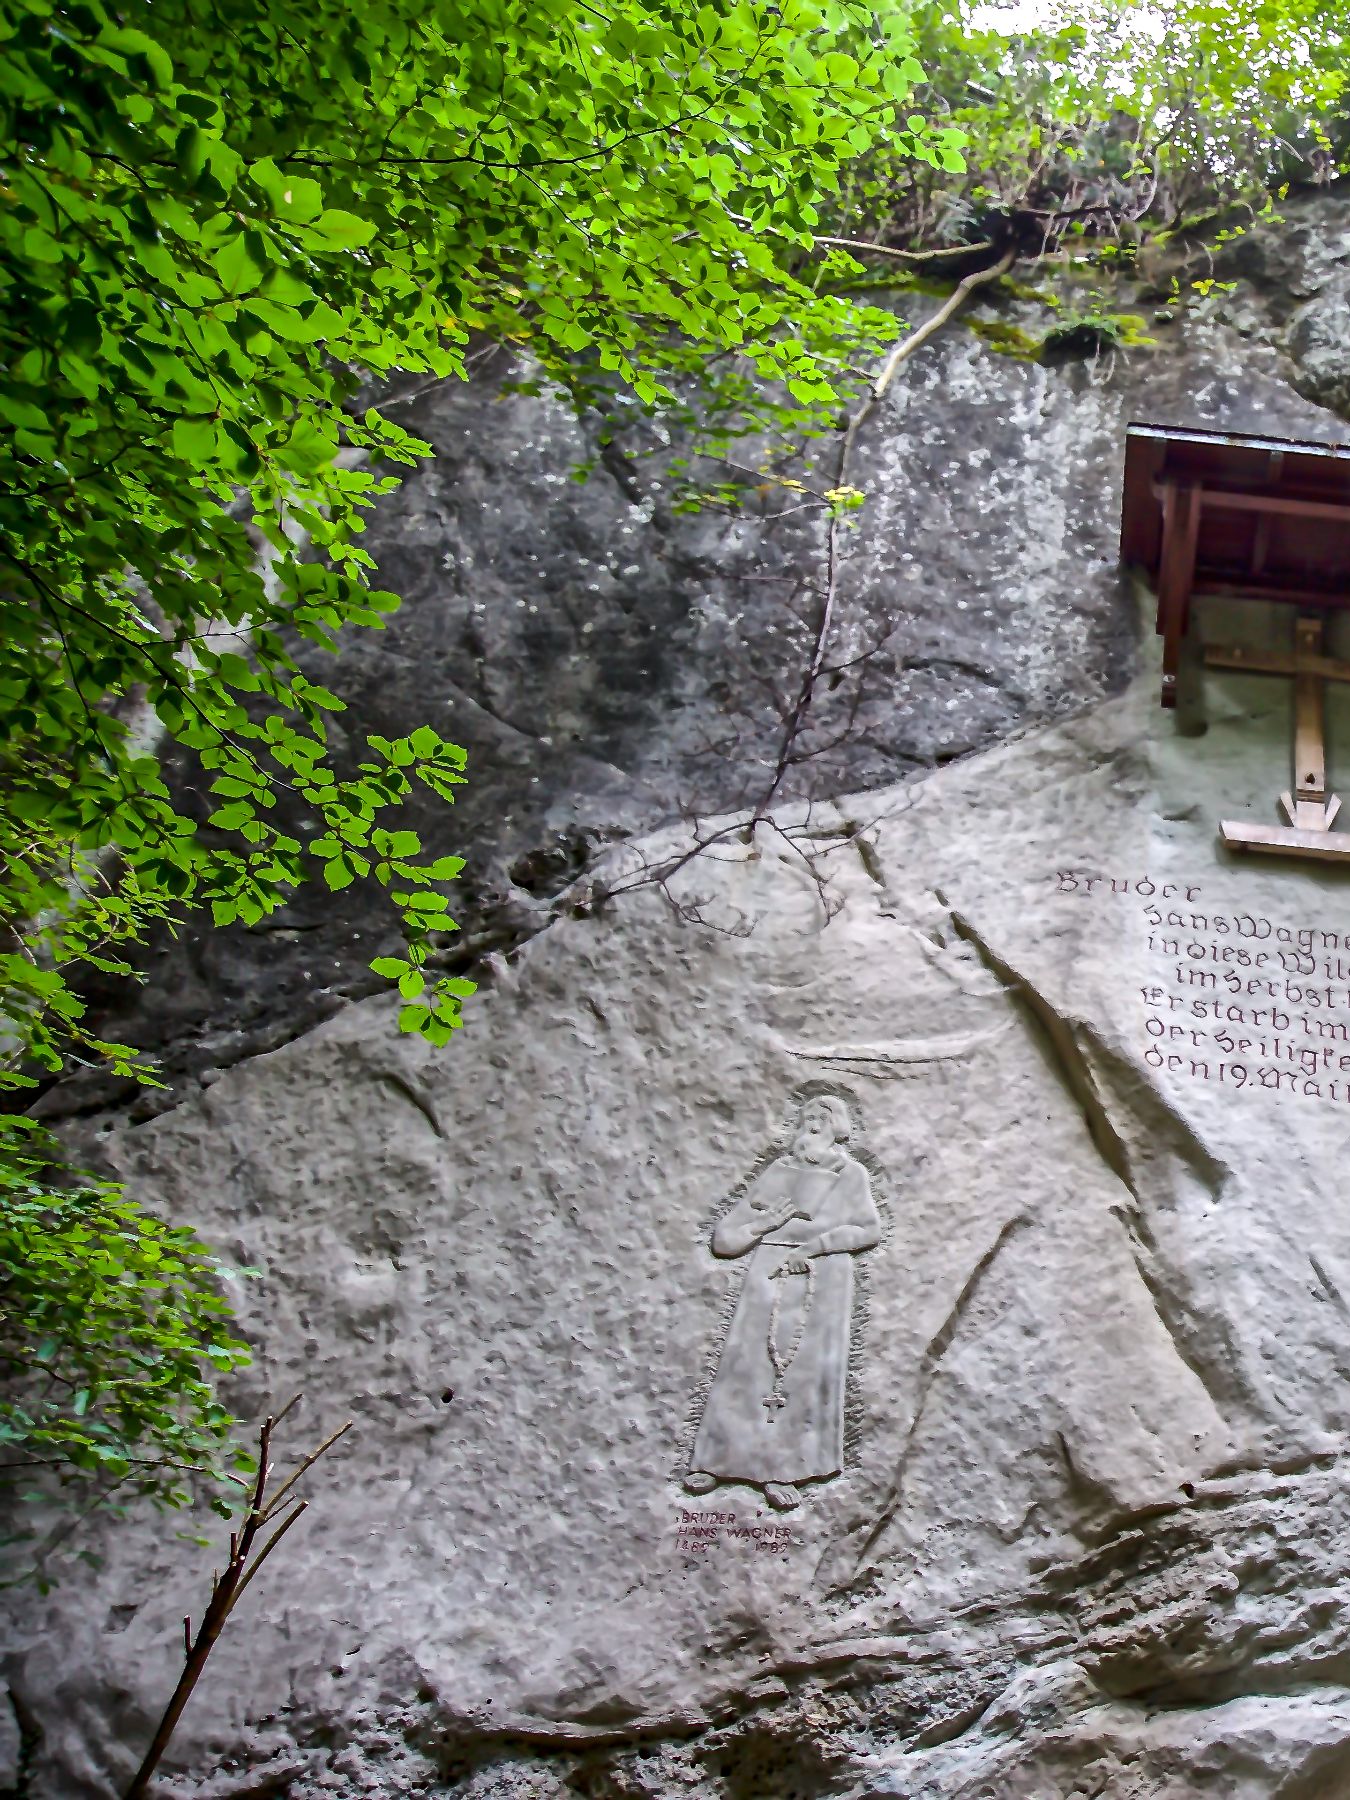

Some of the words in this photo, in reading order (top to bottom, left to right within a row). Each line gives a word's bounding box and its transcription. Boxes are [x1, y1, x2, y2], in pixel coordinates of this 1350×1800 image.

[1056, 870, 1202, 903] Bruder
[1148, 930, 1180, 956] in
[1187, 937, 1269, 969] diese
[1176, 962, 1217, 989] im
[1223, 970, 1336, 1009] Herbst
[1140, 986, 1184, 1011] Er
[1191, 1000, 1290, 1031] starb
[1301, 1011, 1350, 1042] im
[1145, 1016, 1208, 1047] der
[1144, 1044, 1210, 1080] den
[1219, 1063, 1254, 1089] 19.
[1256, 1067, 1338, 1101] Mai
[678, 1526, 719, 1539] HANS
[726, 1526, 792, 1540] WAGNER
[682, 1509, 737, 1525] BRUDER
